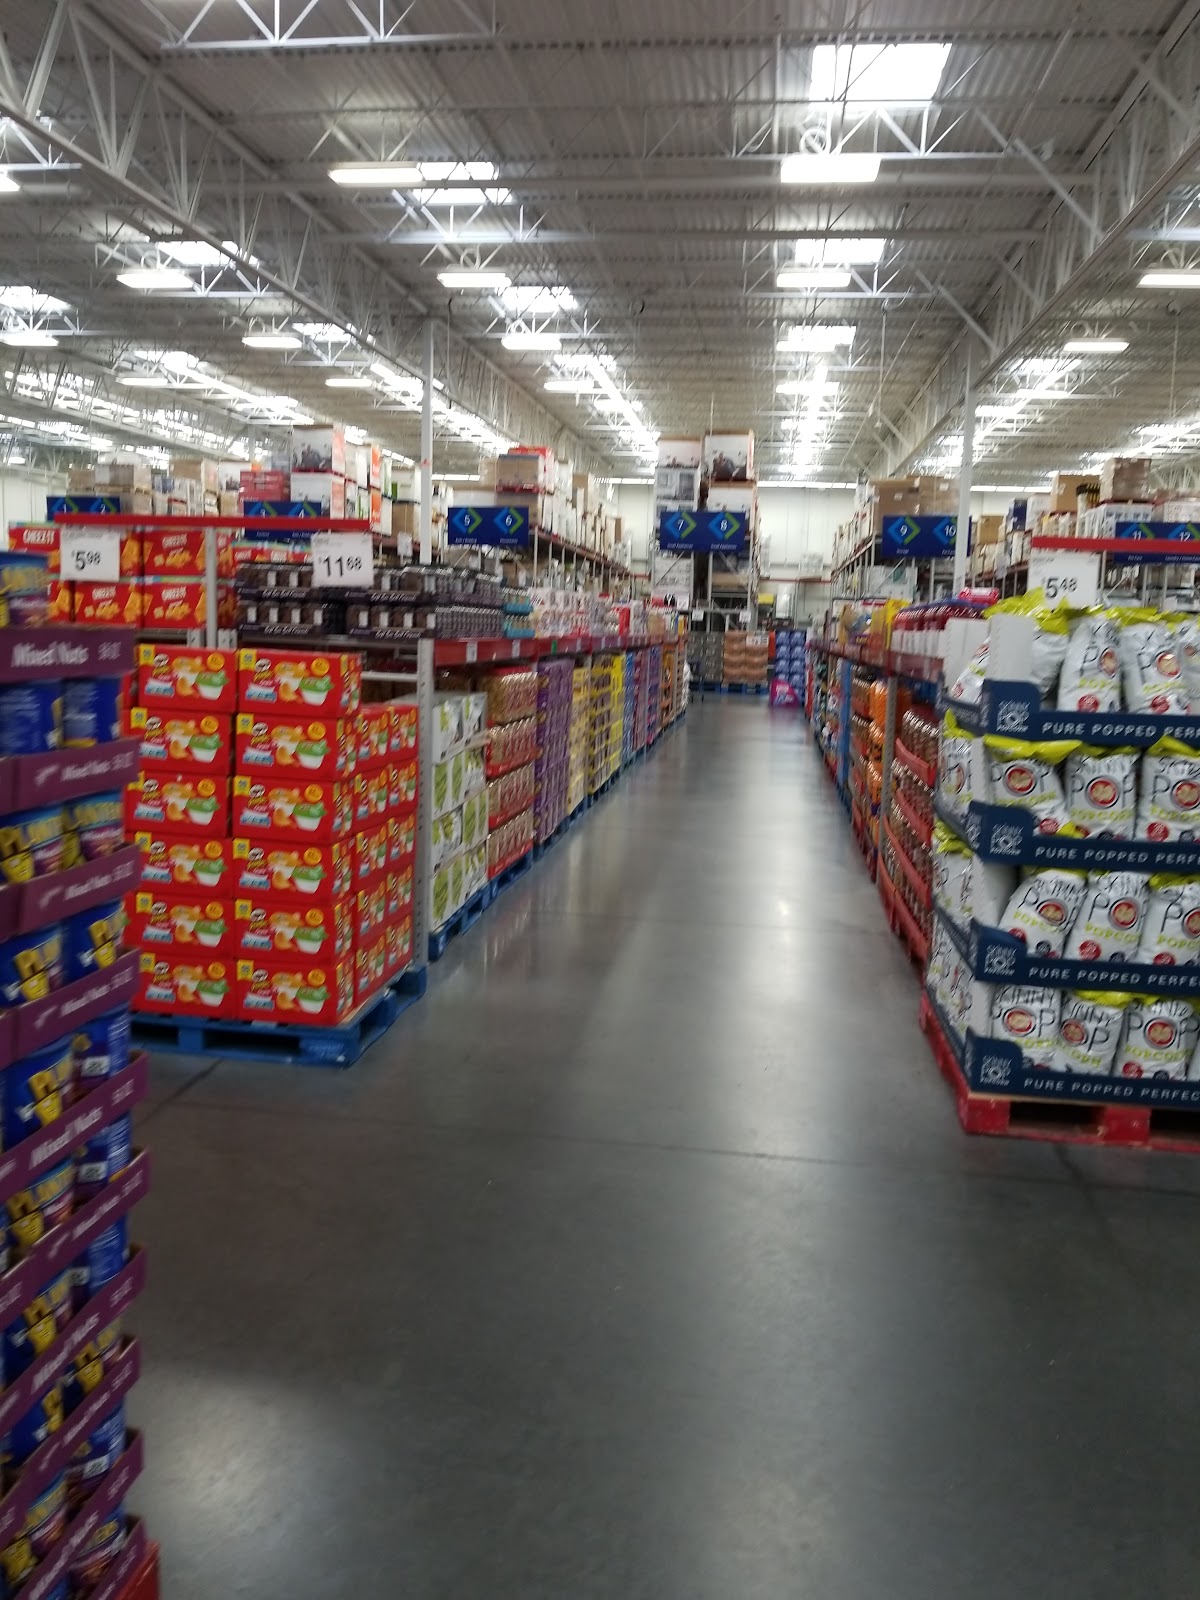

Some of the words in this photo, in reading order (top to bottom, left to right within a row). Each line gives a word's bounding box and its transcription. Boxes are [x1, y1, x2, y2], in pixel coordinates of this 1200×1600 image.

[464, 515, 471, 526] 5
[505, 515, 513, 526] 6
[677, 519, 685, 531] 7
[720, 519, 728, 531] 8
[900, 524, 908, 537] 9
[944, 524, 957, 537] 10
[1178, 531, 1191, 542] 12
[1042, 721, 1086, 735] PURE
[1091, 723, 1157, 738] POPPED
[1034, 846, 1079, 860] PURE
[1084, 848, 1149, 863] POPPED
[1028, 966, 1071, 980] PURE
[1077, 969, 1141, 984] POPPED
[1126, 1012, 1200, 1050] POP
[1023, 1077, 1065, 1091] PURE
[1071, 1082, 1133, 1097] POPPED
[1140, 1087, 1200, 1101] PERFEC
